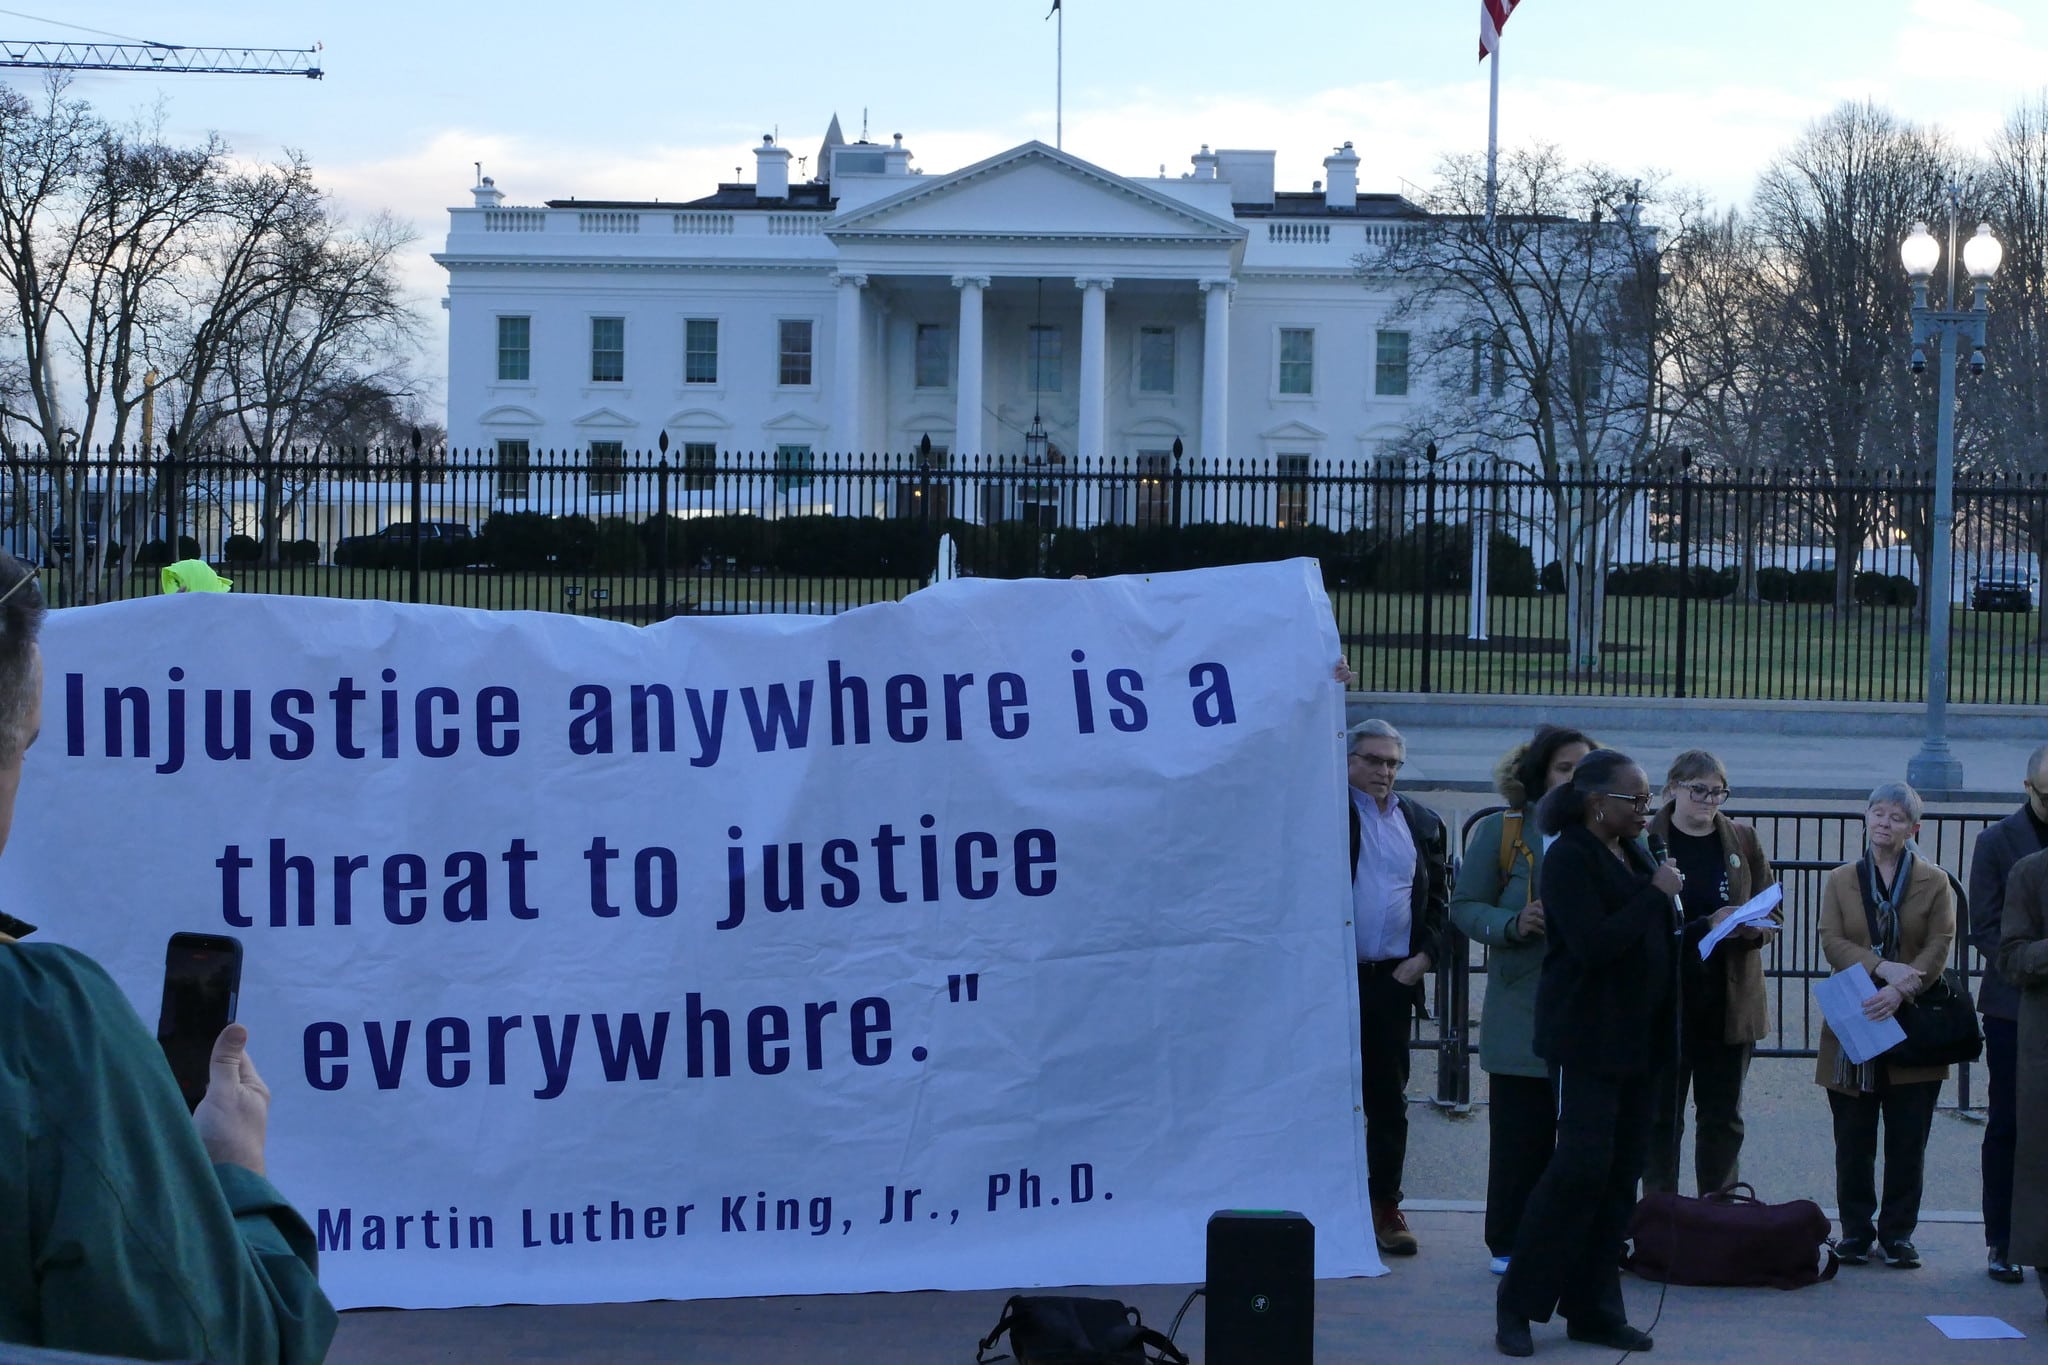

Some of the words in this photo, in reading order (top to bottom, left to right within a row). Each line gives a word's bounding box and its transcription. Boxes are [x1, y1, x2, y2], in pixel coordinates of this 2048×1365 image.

[66, 667, 520, 774] Injustice
[569, 660, 1030, 767] anywhere
[1071, 650, 1148, 734] is
[1189, 663, 1237, 727] a
[216, 838, 539, 927] threat
[584, 837, 678, 918] to
[717, 814, 1057, 930] justice
[303, 973, 979, 1099] everywhere."
[318, 1207, 493, 1251] Martin
[522, 1201, 694, 1248] Luther
[721, 1192, 852, 1235] King,
[880, 1186, 959, 1224] Jr.,
[987, 1163, 1113, 1211] Ph.D.
